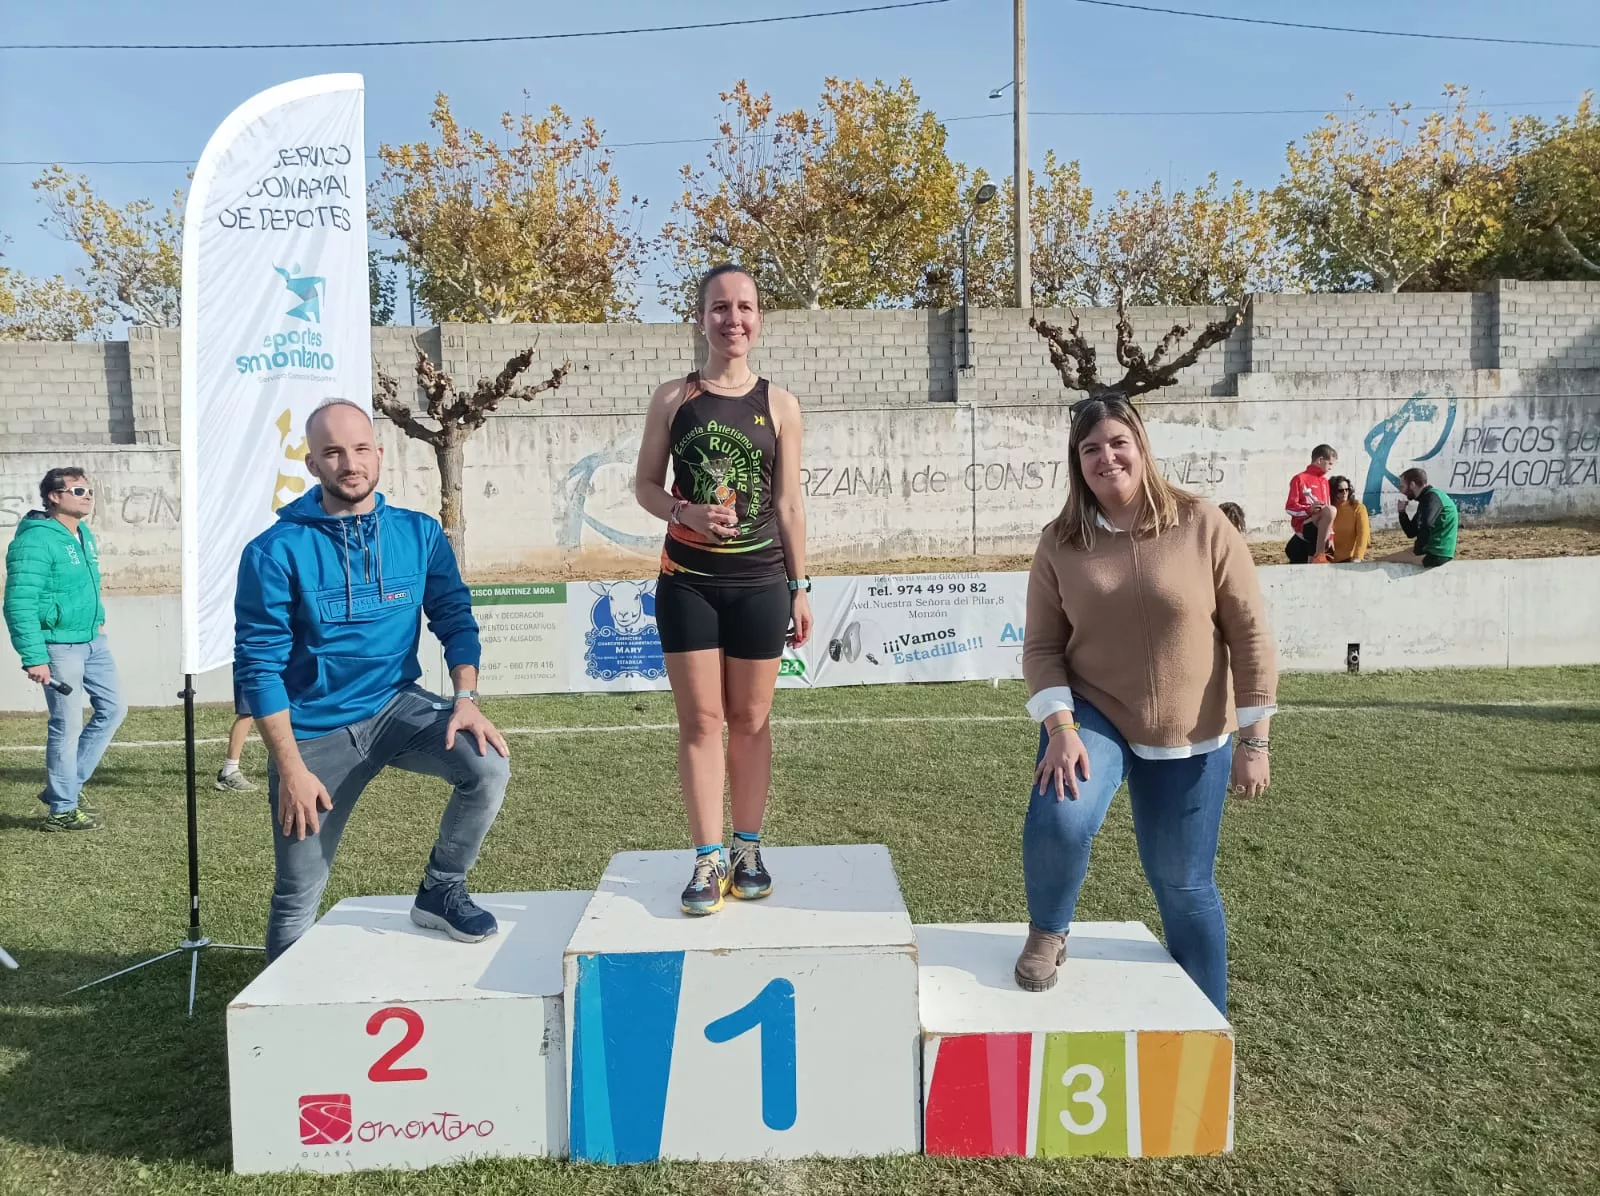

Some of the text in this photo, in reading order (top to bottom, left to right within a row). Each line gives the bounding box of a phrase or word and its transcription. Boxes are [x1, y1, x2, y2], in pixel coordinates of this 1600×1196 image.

[1459, 425, 1558, 454] RIEGOS
[674, 420, 763, 520] Escuela Atletismo Santa Isabel
[911, 464, 947, 494] de
[494, 587, 532, 596] MARTINEZ
[532, 586, 556, 595] MORA
[867, 582, 987, 597] Tel. 974 49 90 82
[915, 597, 951, 607] Señora
[953, 596, 969, 606] del
[908, 609, 948, 619] Monzón
[615, 646, 643, 654] MARY
[365, 1006, 428, 1082] 2
[705, 976, 796, 1131] 1
[1058, 1063, 1108, 1136] 3
